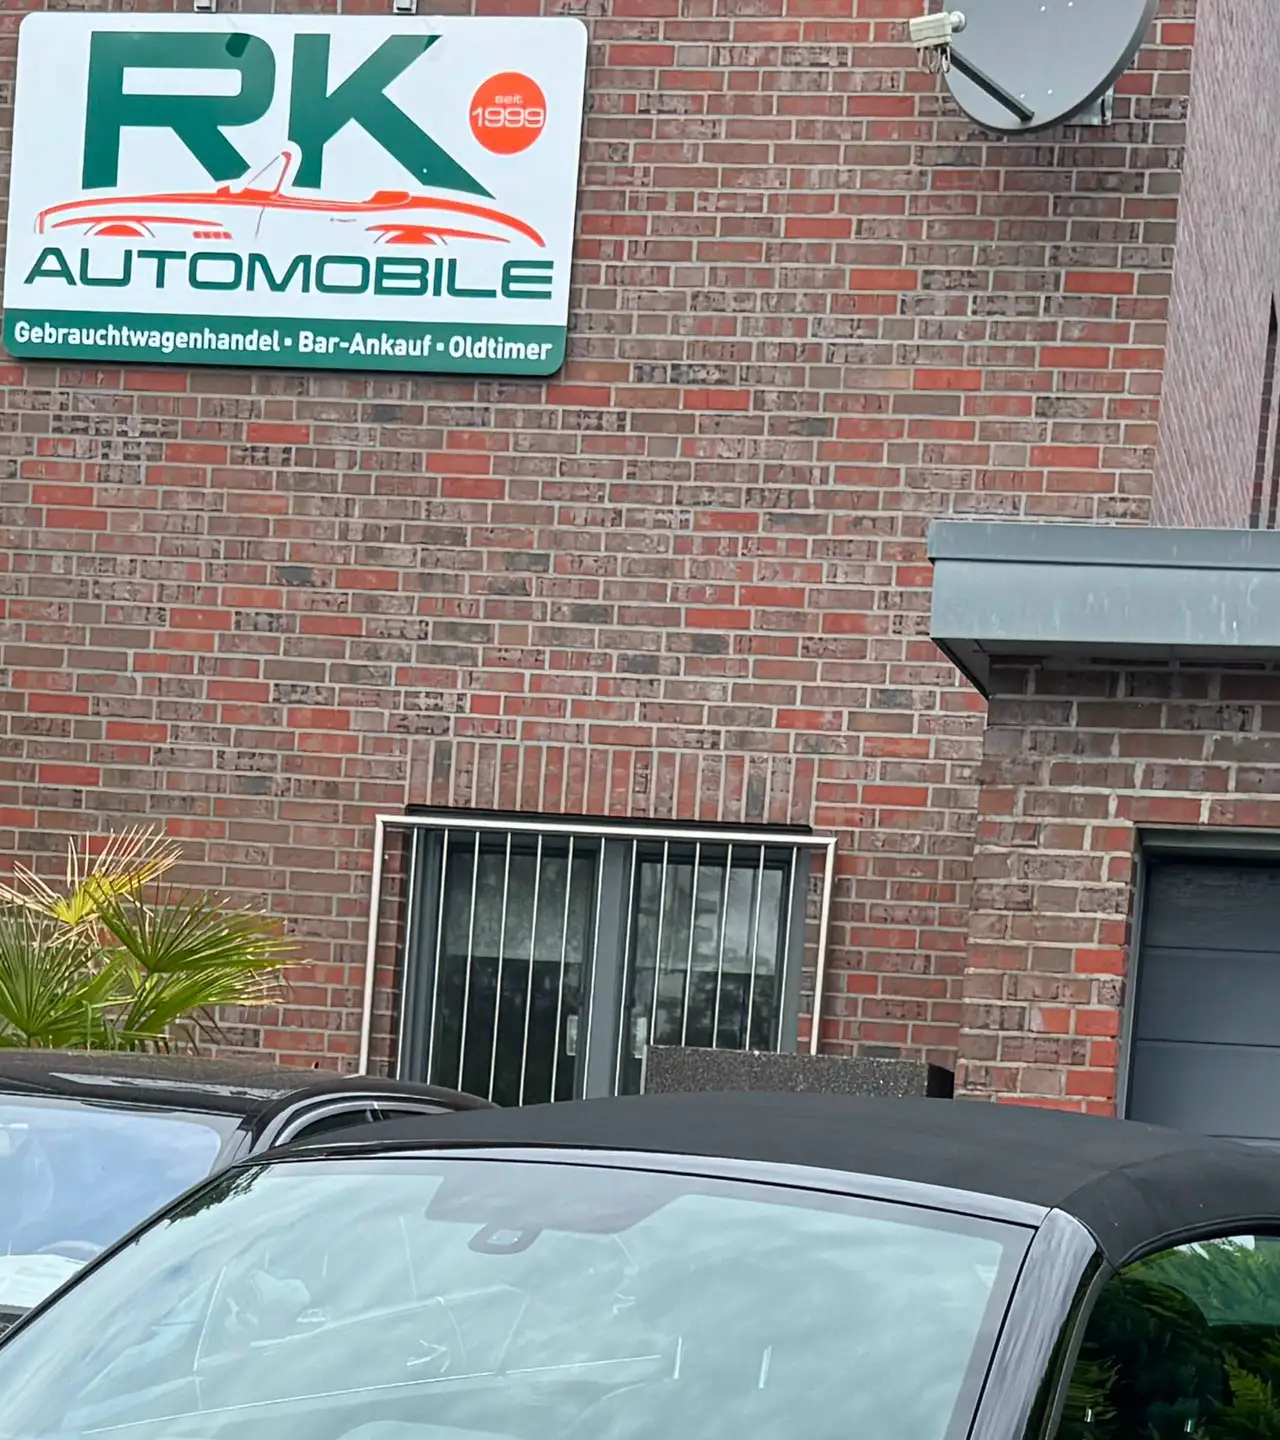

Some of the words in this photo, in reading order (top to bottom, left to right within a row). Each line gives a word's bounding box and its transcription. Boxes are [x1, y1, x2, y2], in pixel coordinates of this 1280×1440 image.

[81, 30, 496, 200] RK
[471, 106, 545, 128] 1999
[494, 94, 524, 105] seit
[23, 247, 554, 300] AUTOMOBILE
[14, 321, 280, 353] Gebrauchtwagenhandel
[298, 331, 432, 357] Bar-Ankauf
[448, 337, 553, 362] Oldtimer
